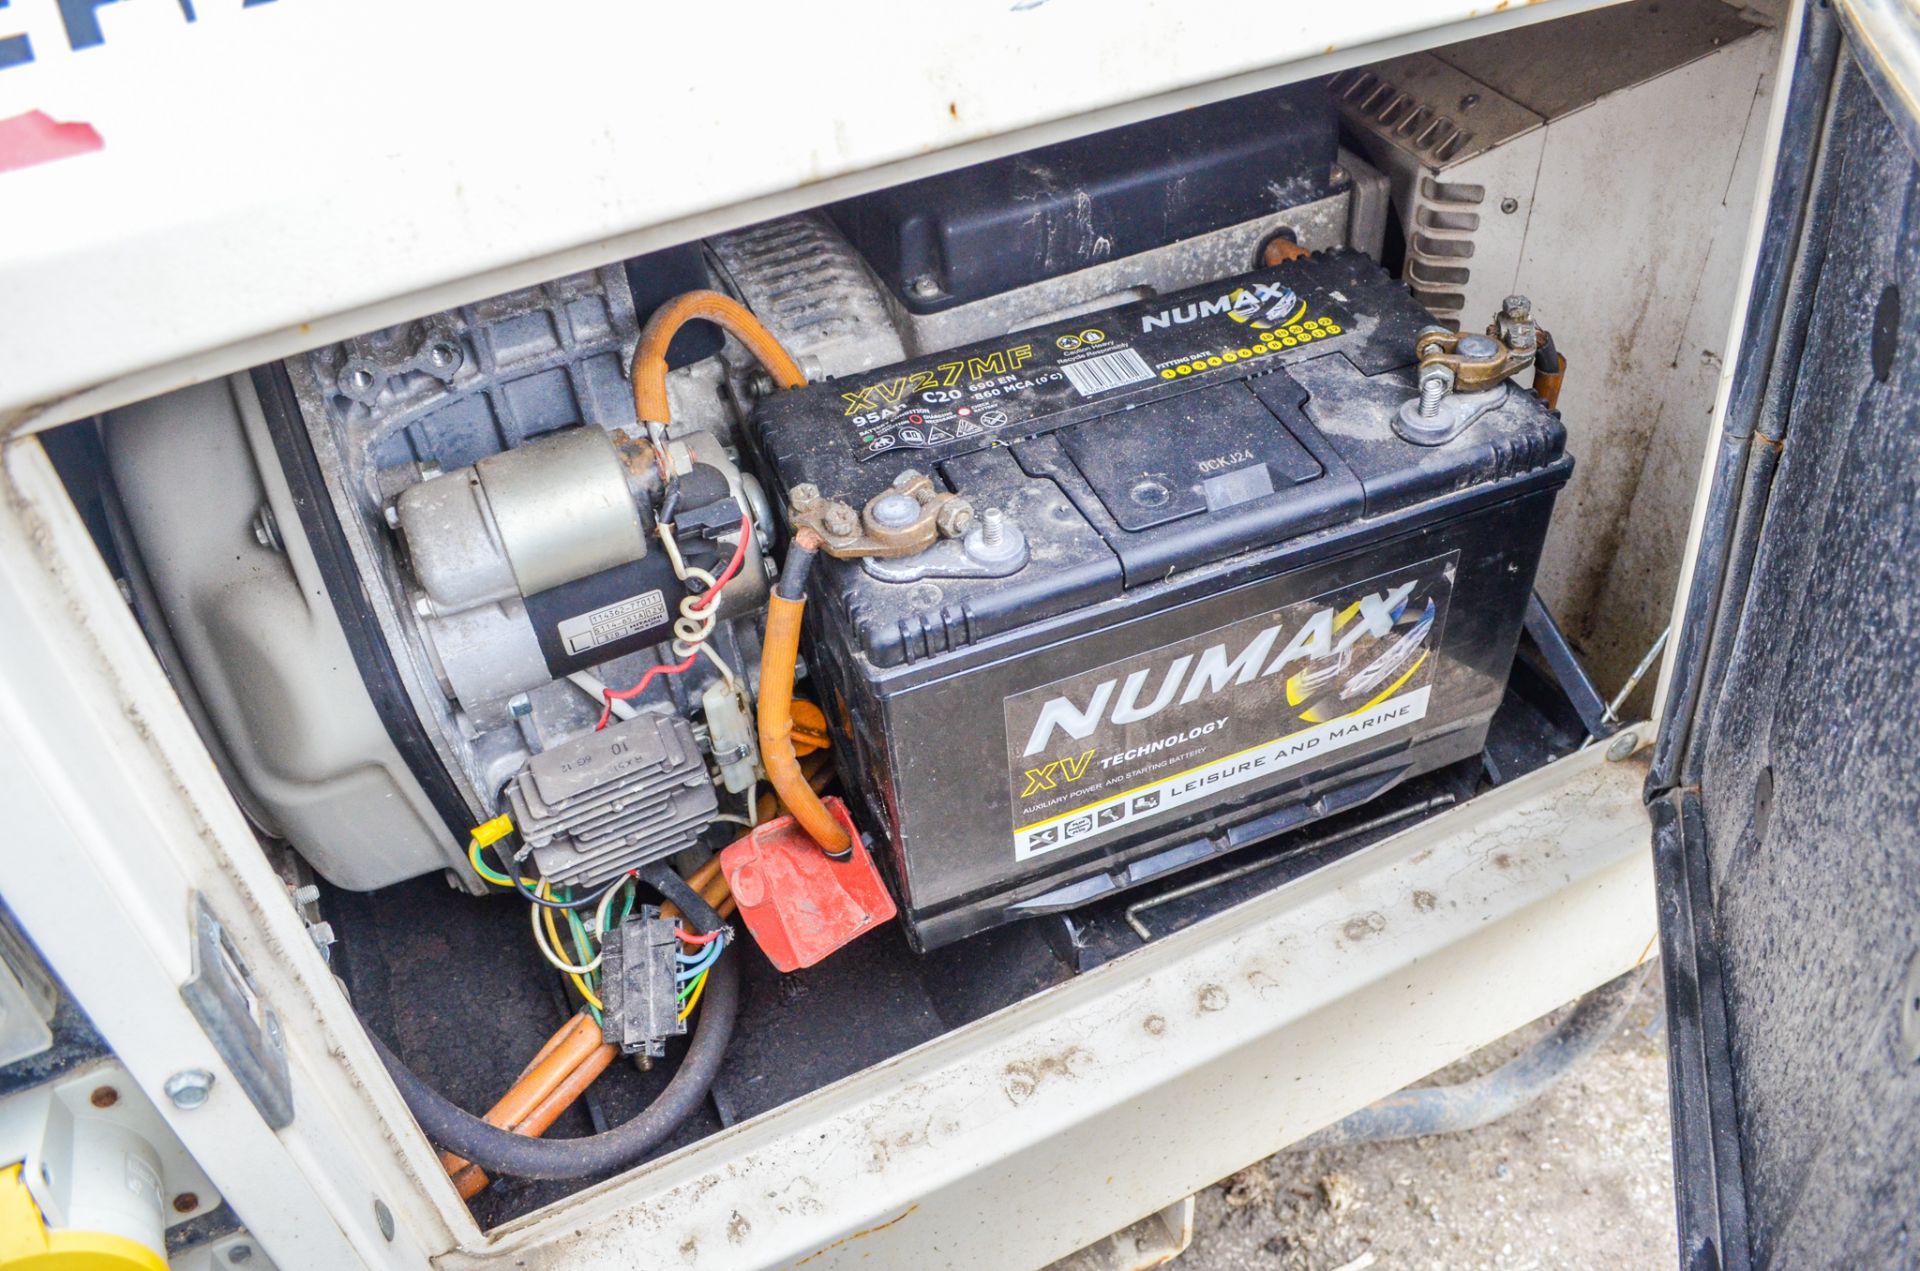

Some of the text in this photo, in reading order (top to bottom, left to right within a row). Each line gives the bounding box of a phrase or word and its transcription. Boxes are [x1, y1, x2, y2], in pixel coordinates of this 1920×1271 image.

[1141, 281, 1284, 333] NUMAX
[1057, 342, 1129, 364] Recycle Responsibly
[1064, 346, 1091, 356] Caution
[1155, 350, 1211, 370] FITTING DATE
[841, 344, 1033, 416] XV27MF
[922, 389, 962, 403] C20
[969, 374, 1018, 393] 690 EN
[975, 388, 1001, 401] 860
[1003, 380, 1035, 395] MCA
[1023, 580, 1418, 758] NUMAX
[1021, 717, 1229, 798] XV TECHNOLOGY
[1170, 704, 1412, 797] LEISURE AND MARINE
[1023, 746, 1208, 815] AUXILIARY POWER AND STARTING BATTERY
